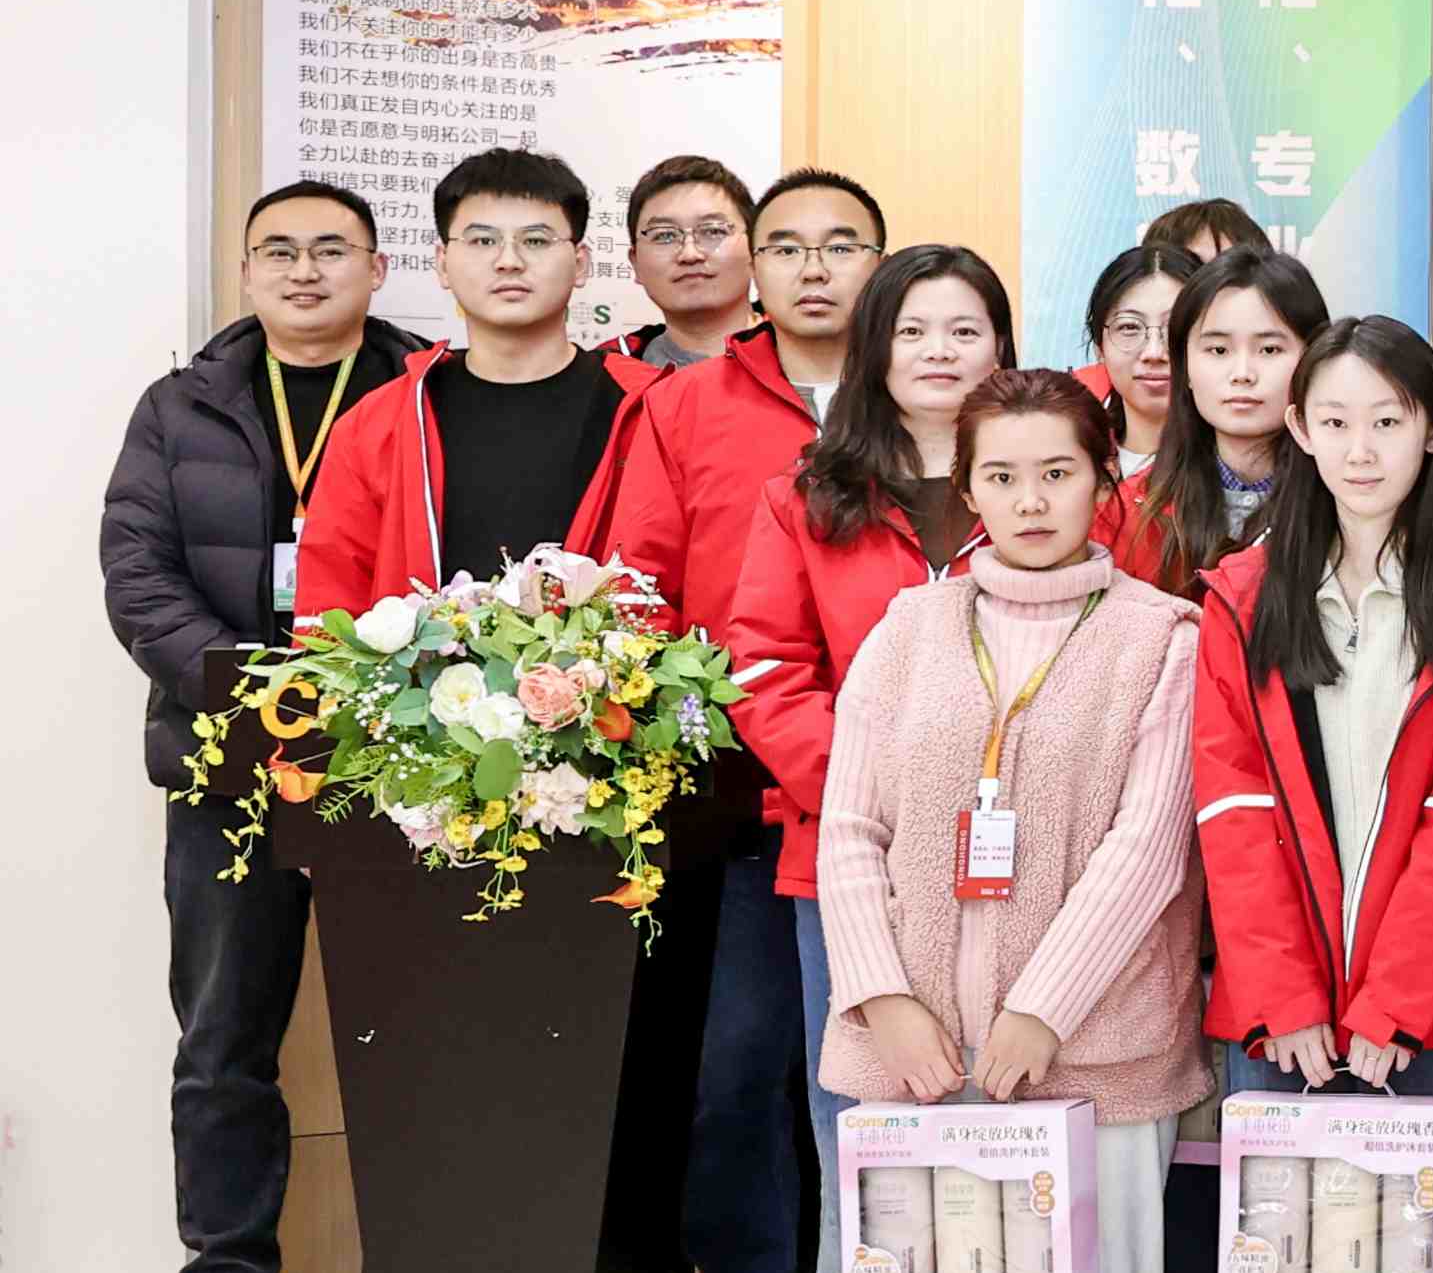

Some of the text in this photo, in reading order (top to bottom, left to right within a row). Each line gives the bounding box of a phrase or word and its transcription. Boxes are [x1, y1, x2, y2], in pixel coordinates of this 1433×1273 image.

[299, 38, 557, 72] 我们不在乎你的出身是否高贵
[299, 65, 557, 98] 我们不去想你的条件是否优秀
[299, 91, 537, 122] 我们真正发自内心关注的是
[299, 118, 538, 148] 你是否愿意与明拓公司一起
[299, 143, 463, 168] 全力以赴的去奋斗
